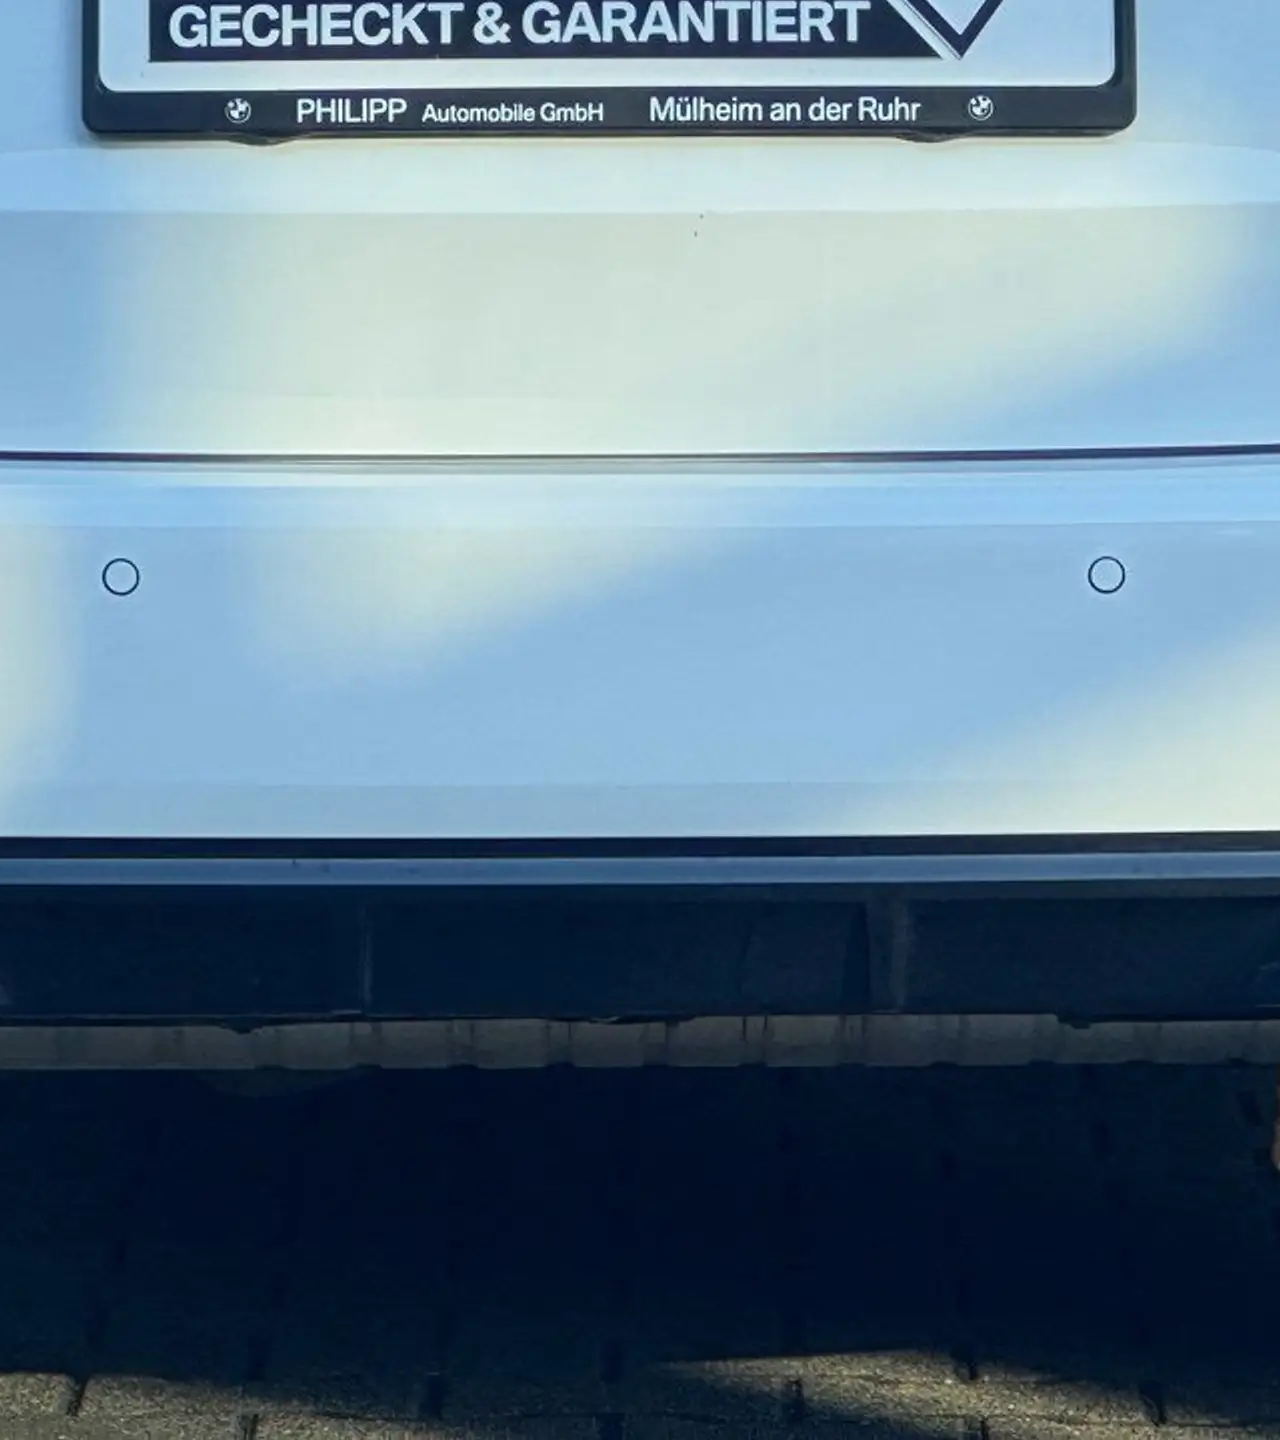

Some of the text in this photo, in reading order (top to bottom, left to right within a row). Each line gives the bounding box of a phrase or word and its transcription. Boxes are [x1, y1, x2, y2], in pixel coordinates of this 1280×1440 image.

[169, 0, 872, 48] GECHECKT & GARANTIERT
[296, 95, 921, 124] PHILIPP Automobile GmbH Mülheim an der Ruhr
